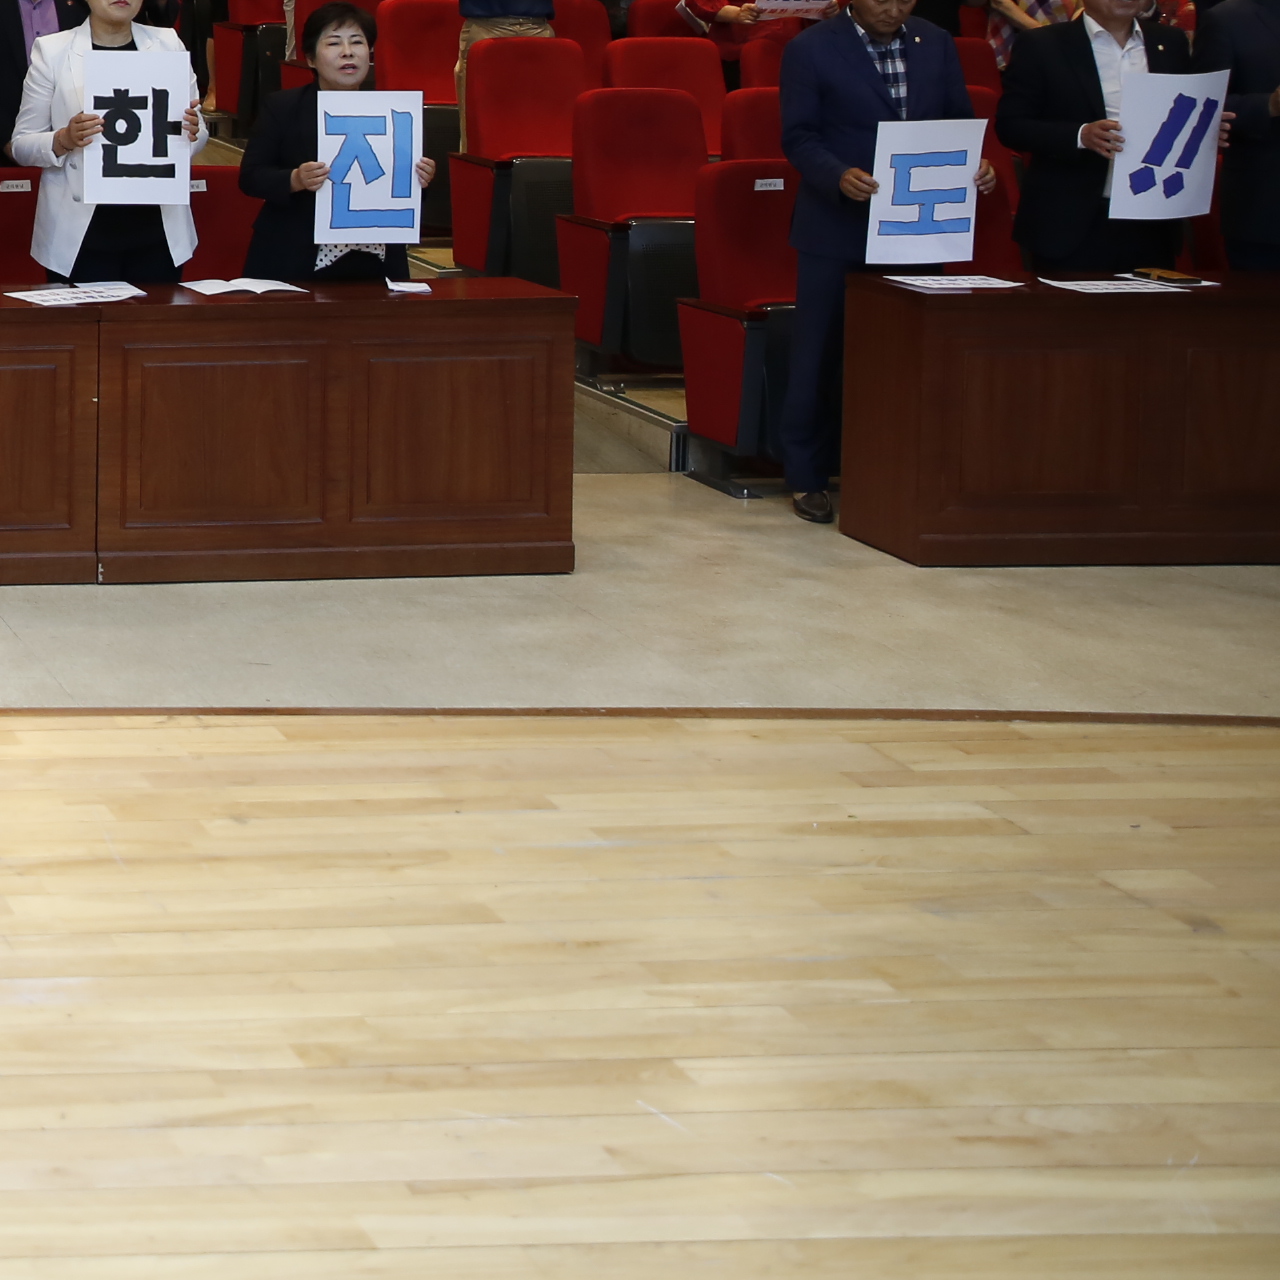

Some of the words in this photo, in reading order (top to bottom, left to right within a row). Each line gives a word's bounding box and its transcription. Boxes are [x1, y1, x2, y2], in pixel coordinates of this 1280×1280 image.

[93, 87, 183, 179] 한
[323, 108, 416, 230] 진
[1127, 92, 1220, 198] !!
[877, 148, 971, 237] 도
